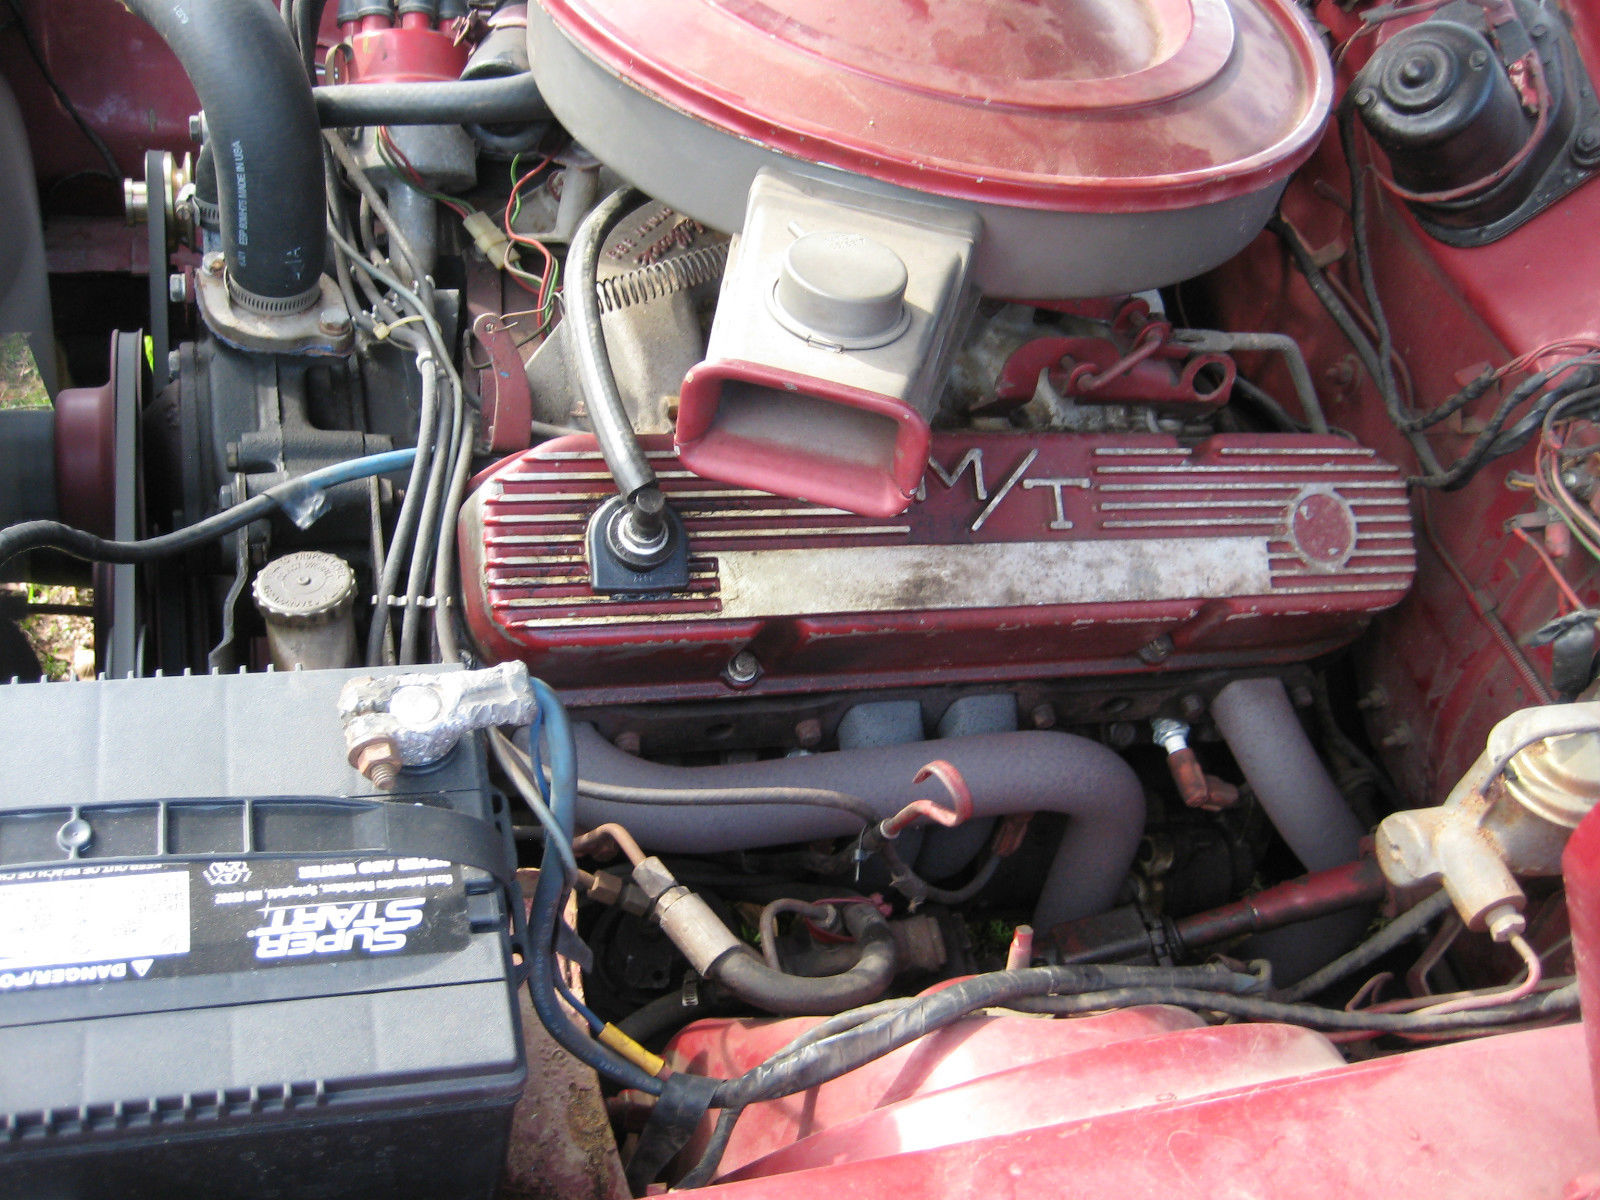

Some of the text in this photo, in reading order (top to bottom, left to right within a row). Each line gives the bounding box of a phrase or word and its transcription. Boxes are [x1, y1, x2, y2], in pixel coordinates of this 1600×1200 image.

[231, 140, 244, 161] USA
[235, 161, 245, 173] IN
[236, 173, 247, 199] MADE
[252, 896, 427, 938] START
[256, 927, 408, 959] SUPER
